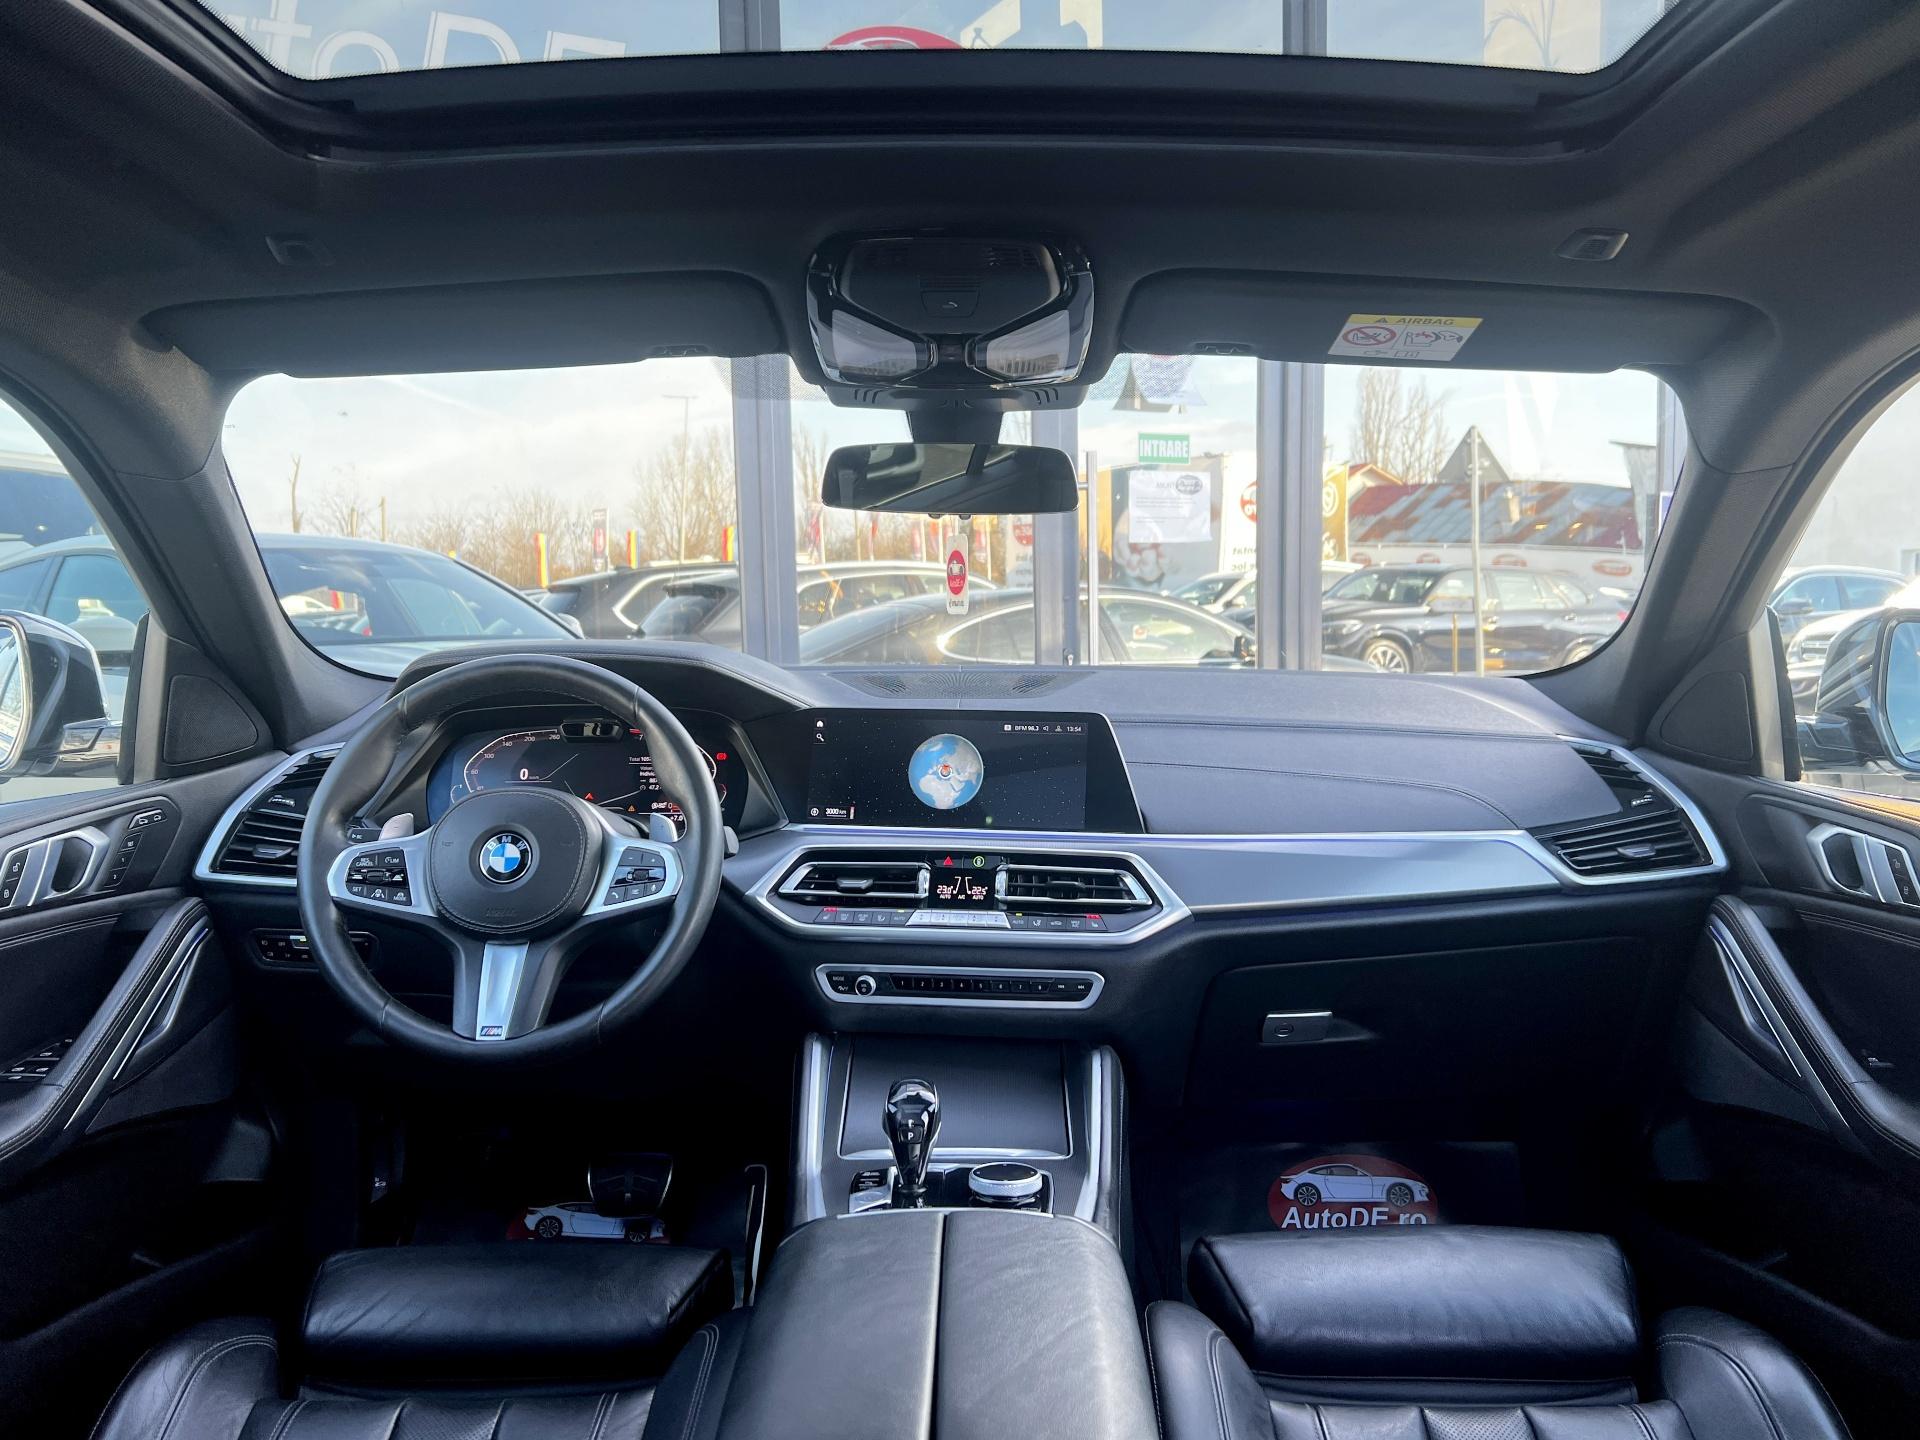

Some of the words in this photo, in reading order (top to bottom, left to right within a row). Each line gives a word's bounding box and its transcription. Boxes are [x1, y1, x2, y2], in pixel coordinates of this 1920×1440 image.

[1396, 317, 1454, 326] AIRBAG
[1139, 439, 1189, 458] INTRARE
[519, 768, 529, 780] 0
[487, 836, 527, 850] BMW
[907, 1131, 914, 1140] P
[1281, 1206, 1427, 1229] AutoDFro
